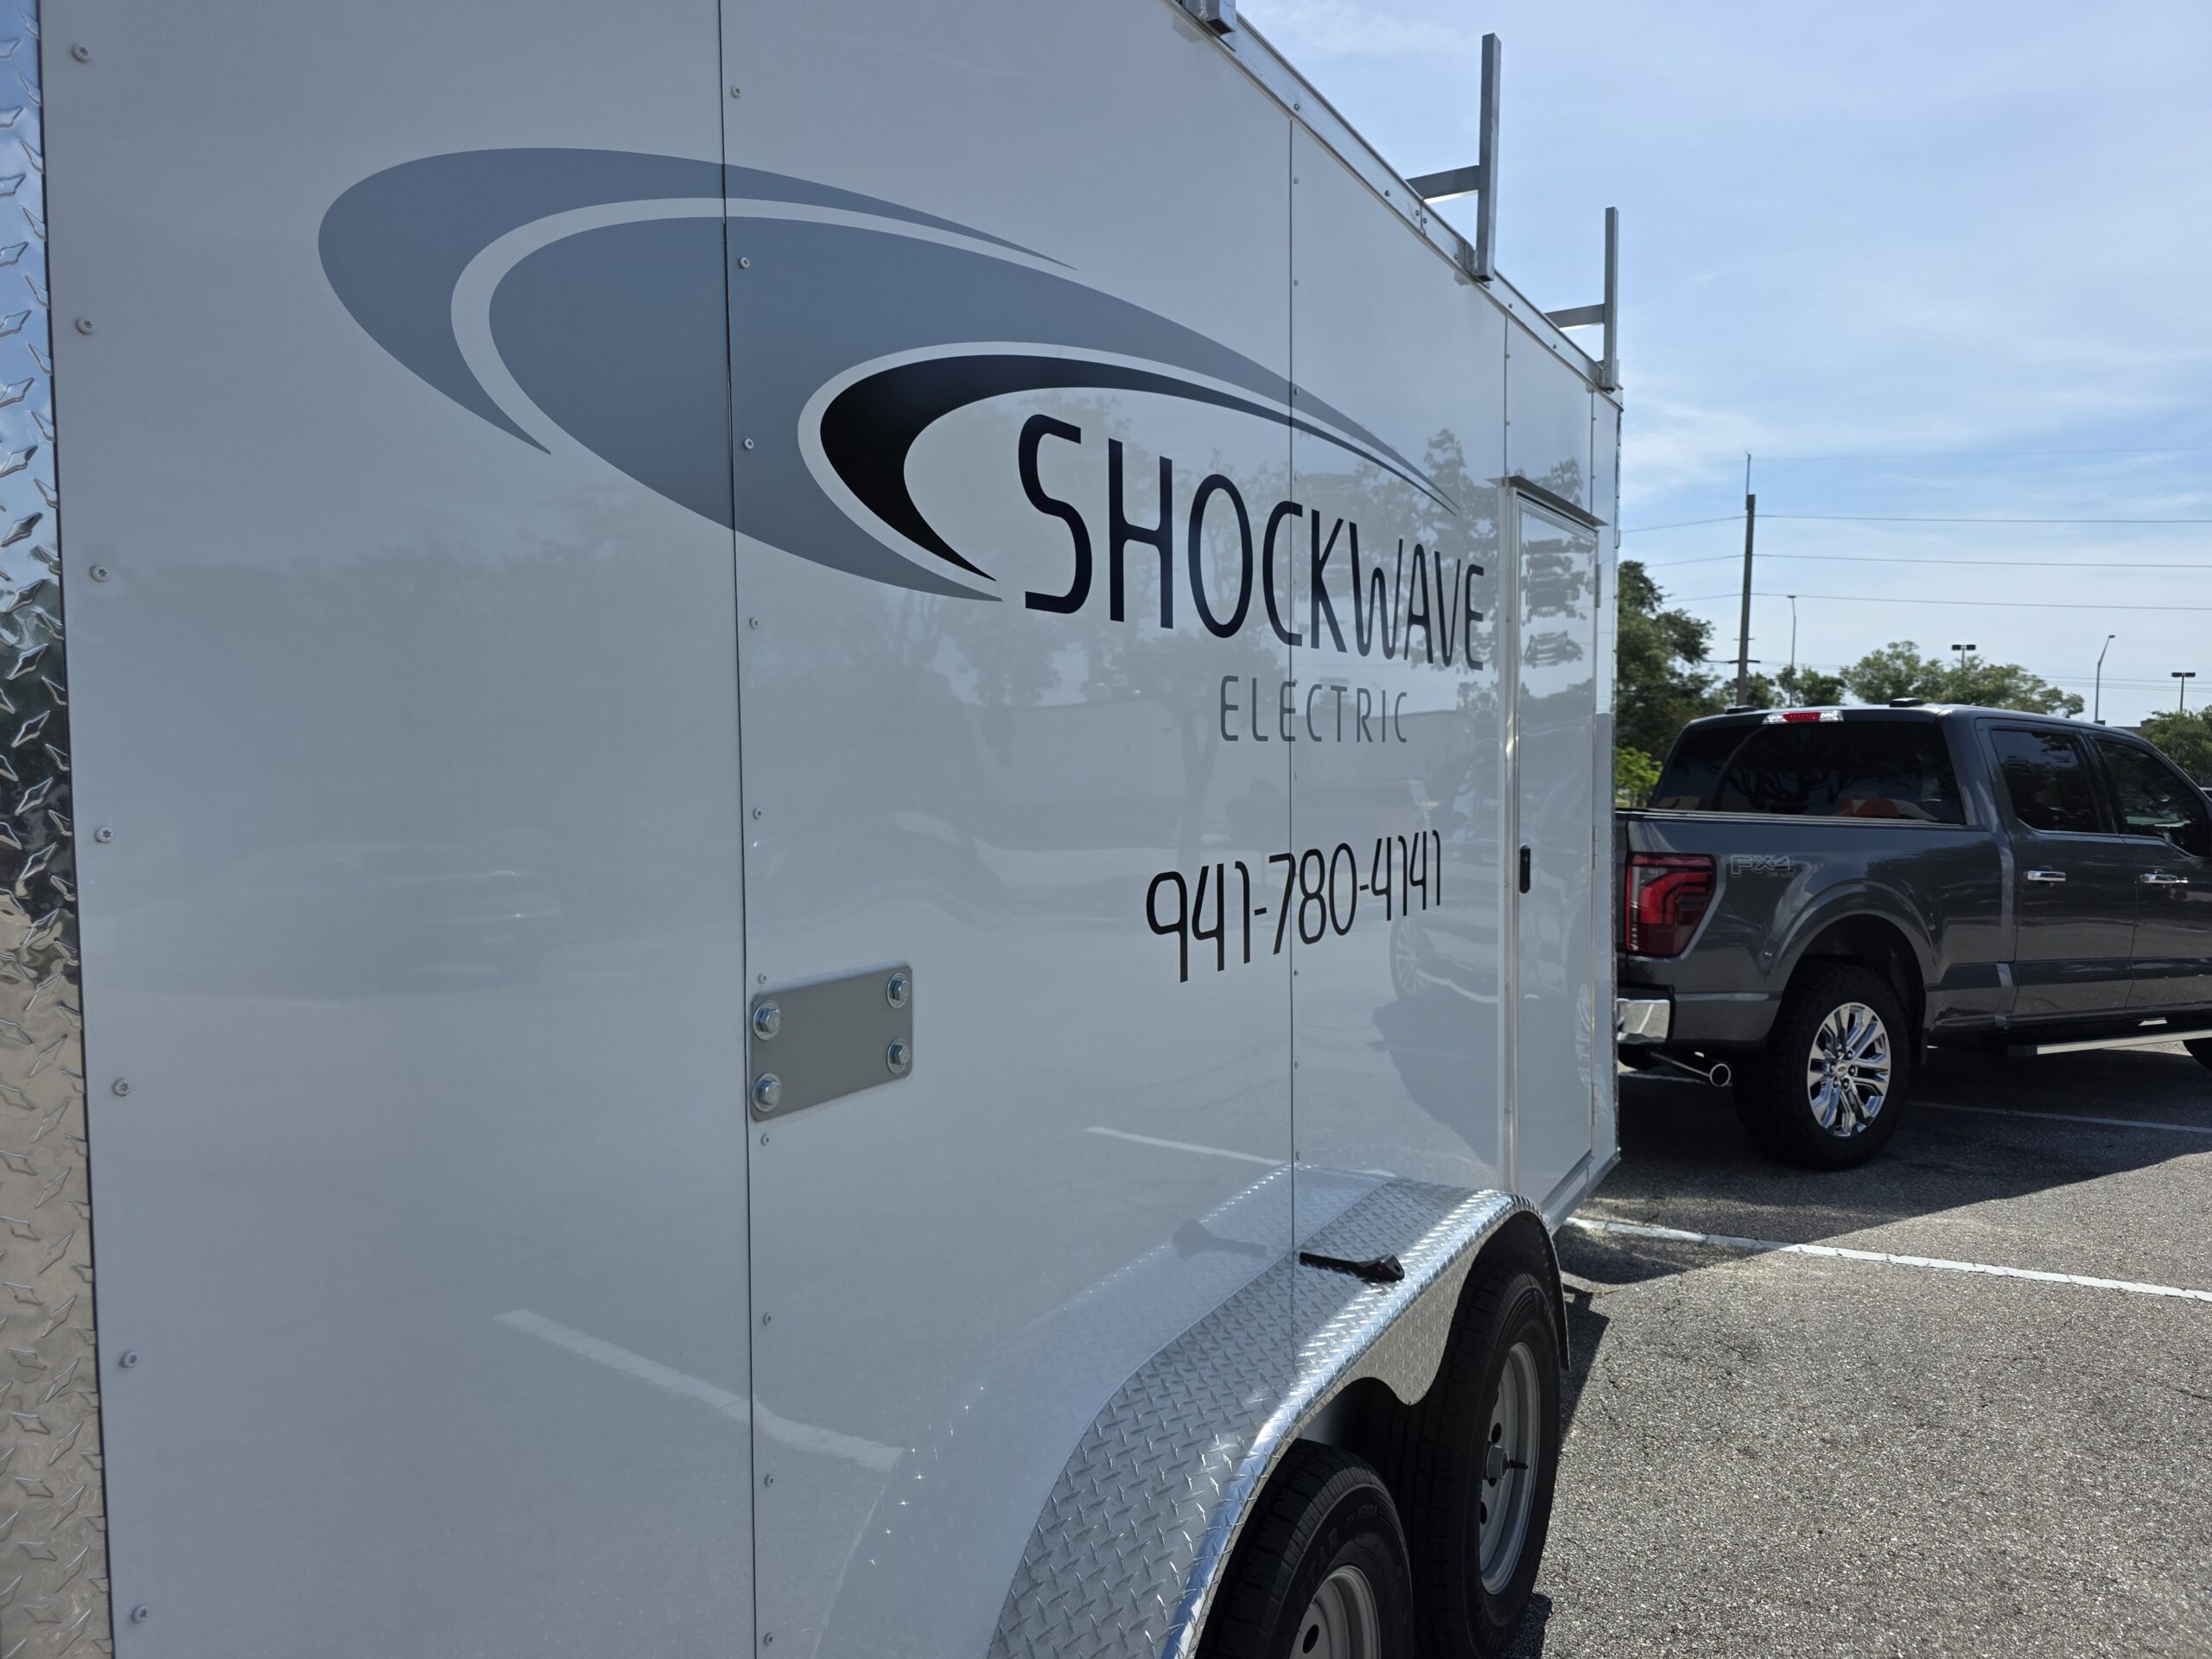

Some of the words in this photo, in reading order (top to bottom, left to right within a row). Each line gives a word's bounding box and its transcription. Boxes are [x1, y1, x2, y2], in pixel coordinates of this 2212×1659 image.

[1018, 413, 1484, 671] SHOCKWAVE
[1219, 675, 1408, 743] ELECTRIC
[1146, 830, 1441, 983] 941-780-4141
[1730, 854, 1796, 878] FX4
